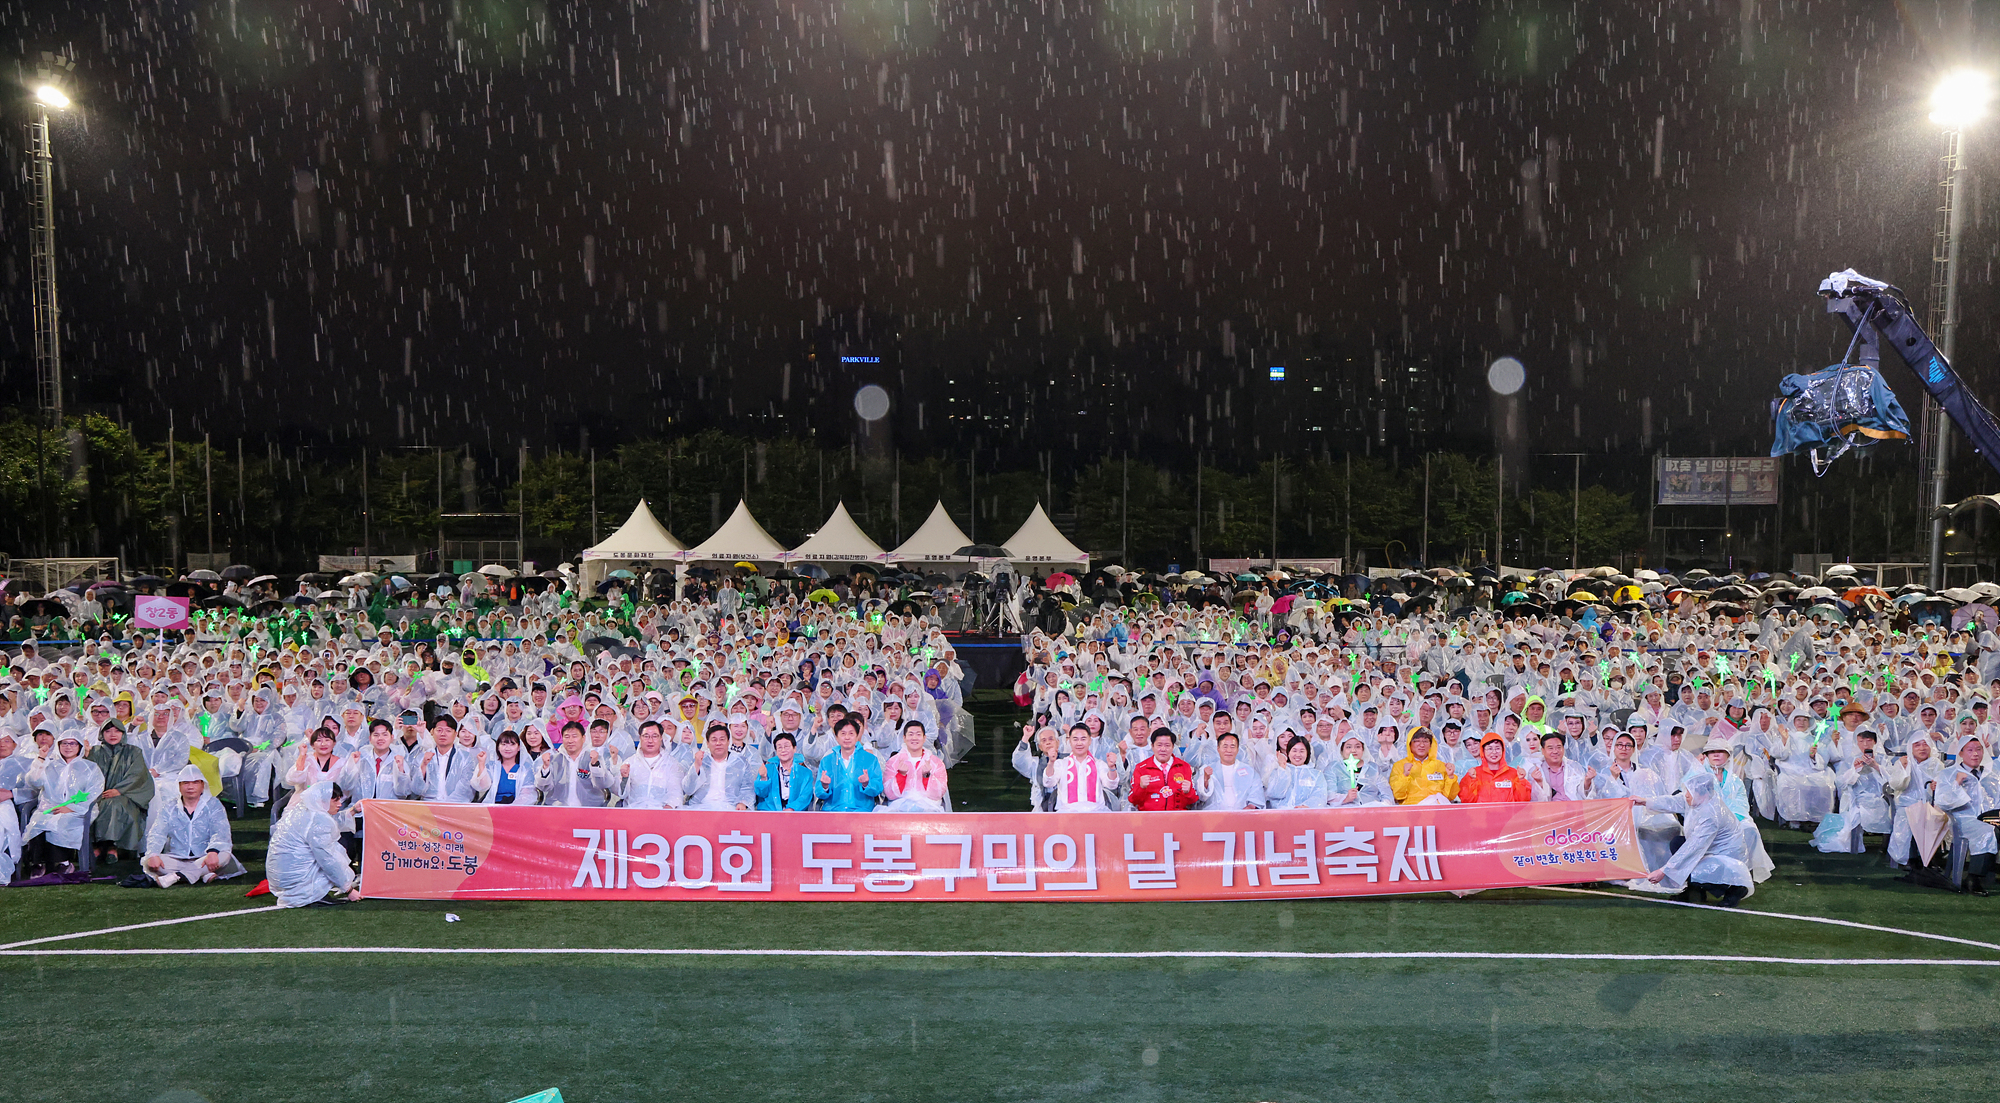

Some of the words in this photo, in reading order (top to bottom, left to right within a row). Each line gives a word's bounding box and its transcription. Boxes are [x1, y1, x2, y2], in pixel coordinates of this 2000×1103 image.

[145, 606, 178, 619] 창2동
[398, 824, 464, 843] dobong
[1544, 828, 1616, 846] dobong
[397, 840, 465, 853] 변화·성장·미래
[381, 850, 445, 871] 함께해요!
[446, 855, 478, 876] 도봉
[571, 828, 773, 892] 제30회
[799, 832, 1098, 893] 도봉구민의
[1124, 832, 1181, 890] 날
[1202, 825, 1443, 887] 기념축제
[1513, 855, 1535, 867] 같이
[1535, 852, 1562, 865] 변화,
[1562, 849, 1598, 863] 행복한
[1599, 847, 1618, 861] 도봉
